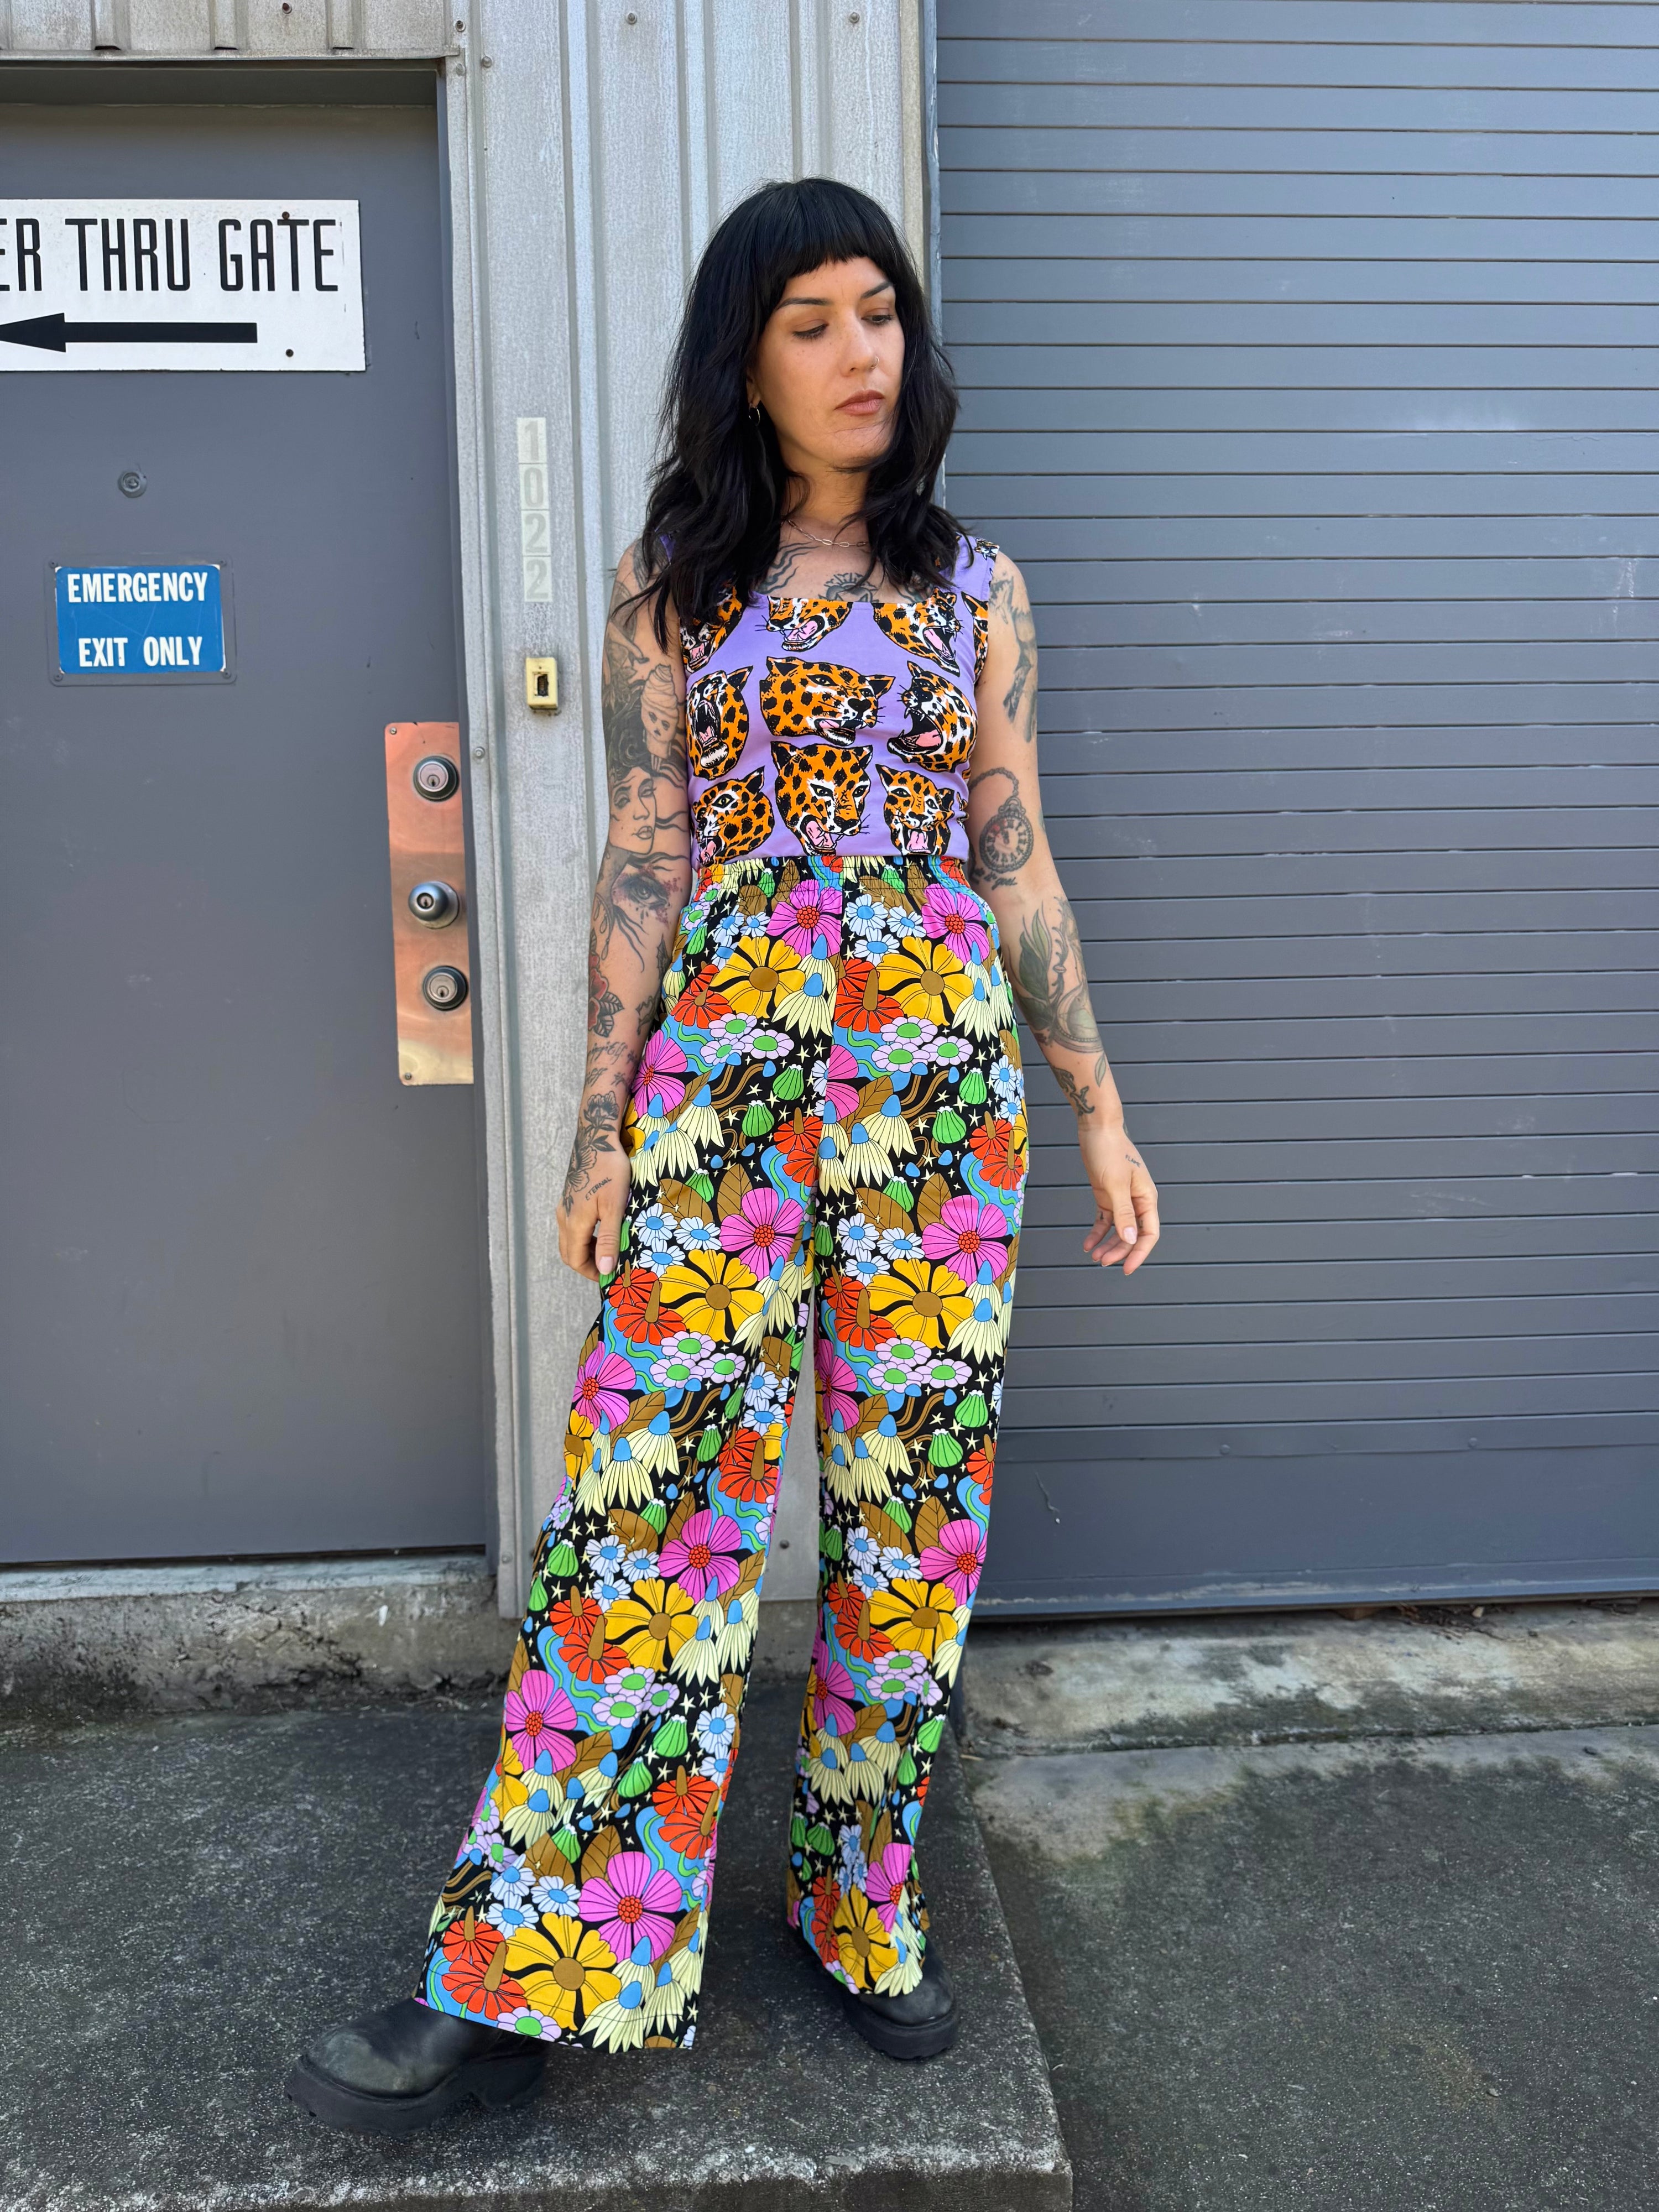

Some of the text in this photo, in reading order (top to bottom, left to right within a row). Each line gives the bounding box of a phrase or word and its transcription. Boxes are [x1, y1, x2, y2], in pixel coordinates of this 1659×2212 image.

[65, 218, 190, 291] THRU
[218, 218, 338, 291] GATE
[525, 420, 549, 600] 1022
[67, 572, 208, 603] EMERGENCY
[79, 637, 202, 667] EXIT ONLY
[585, 1177, 612, 1201] ETERNAL
